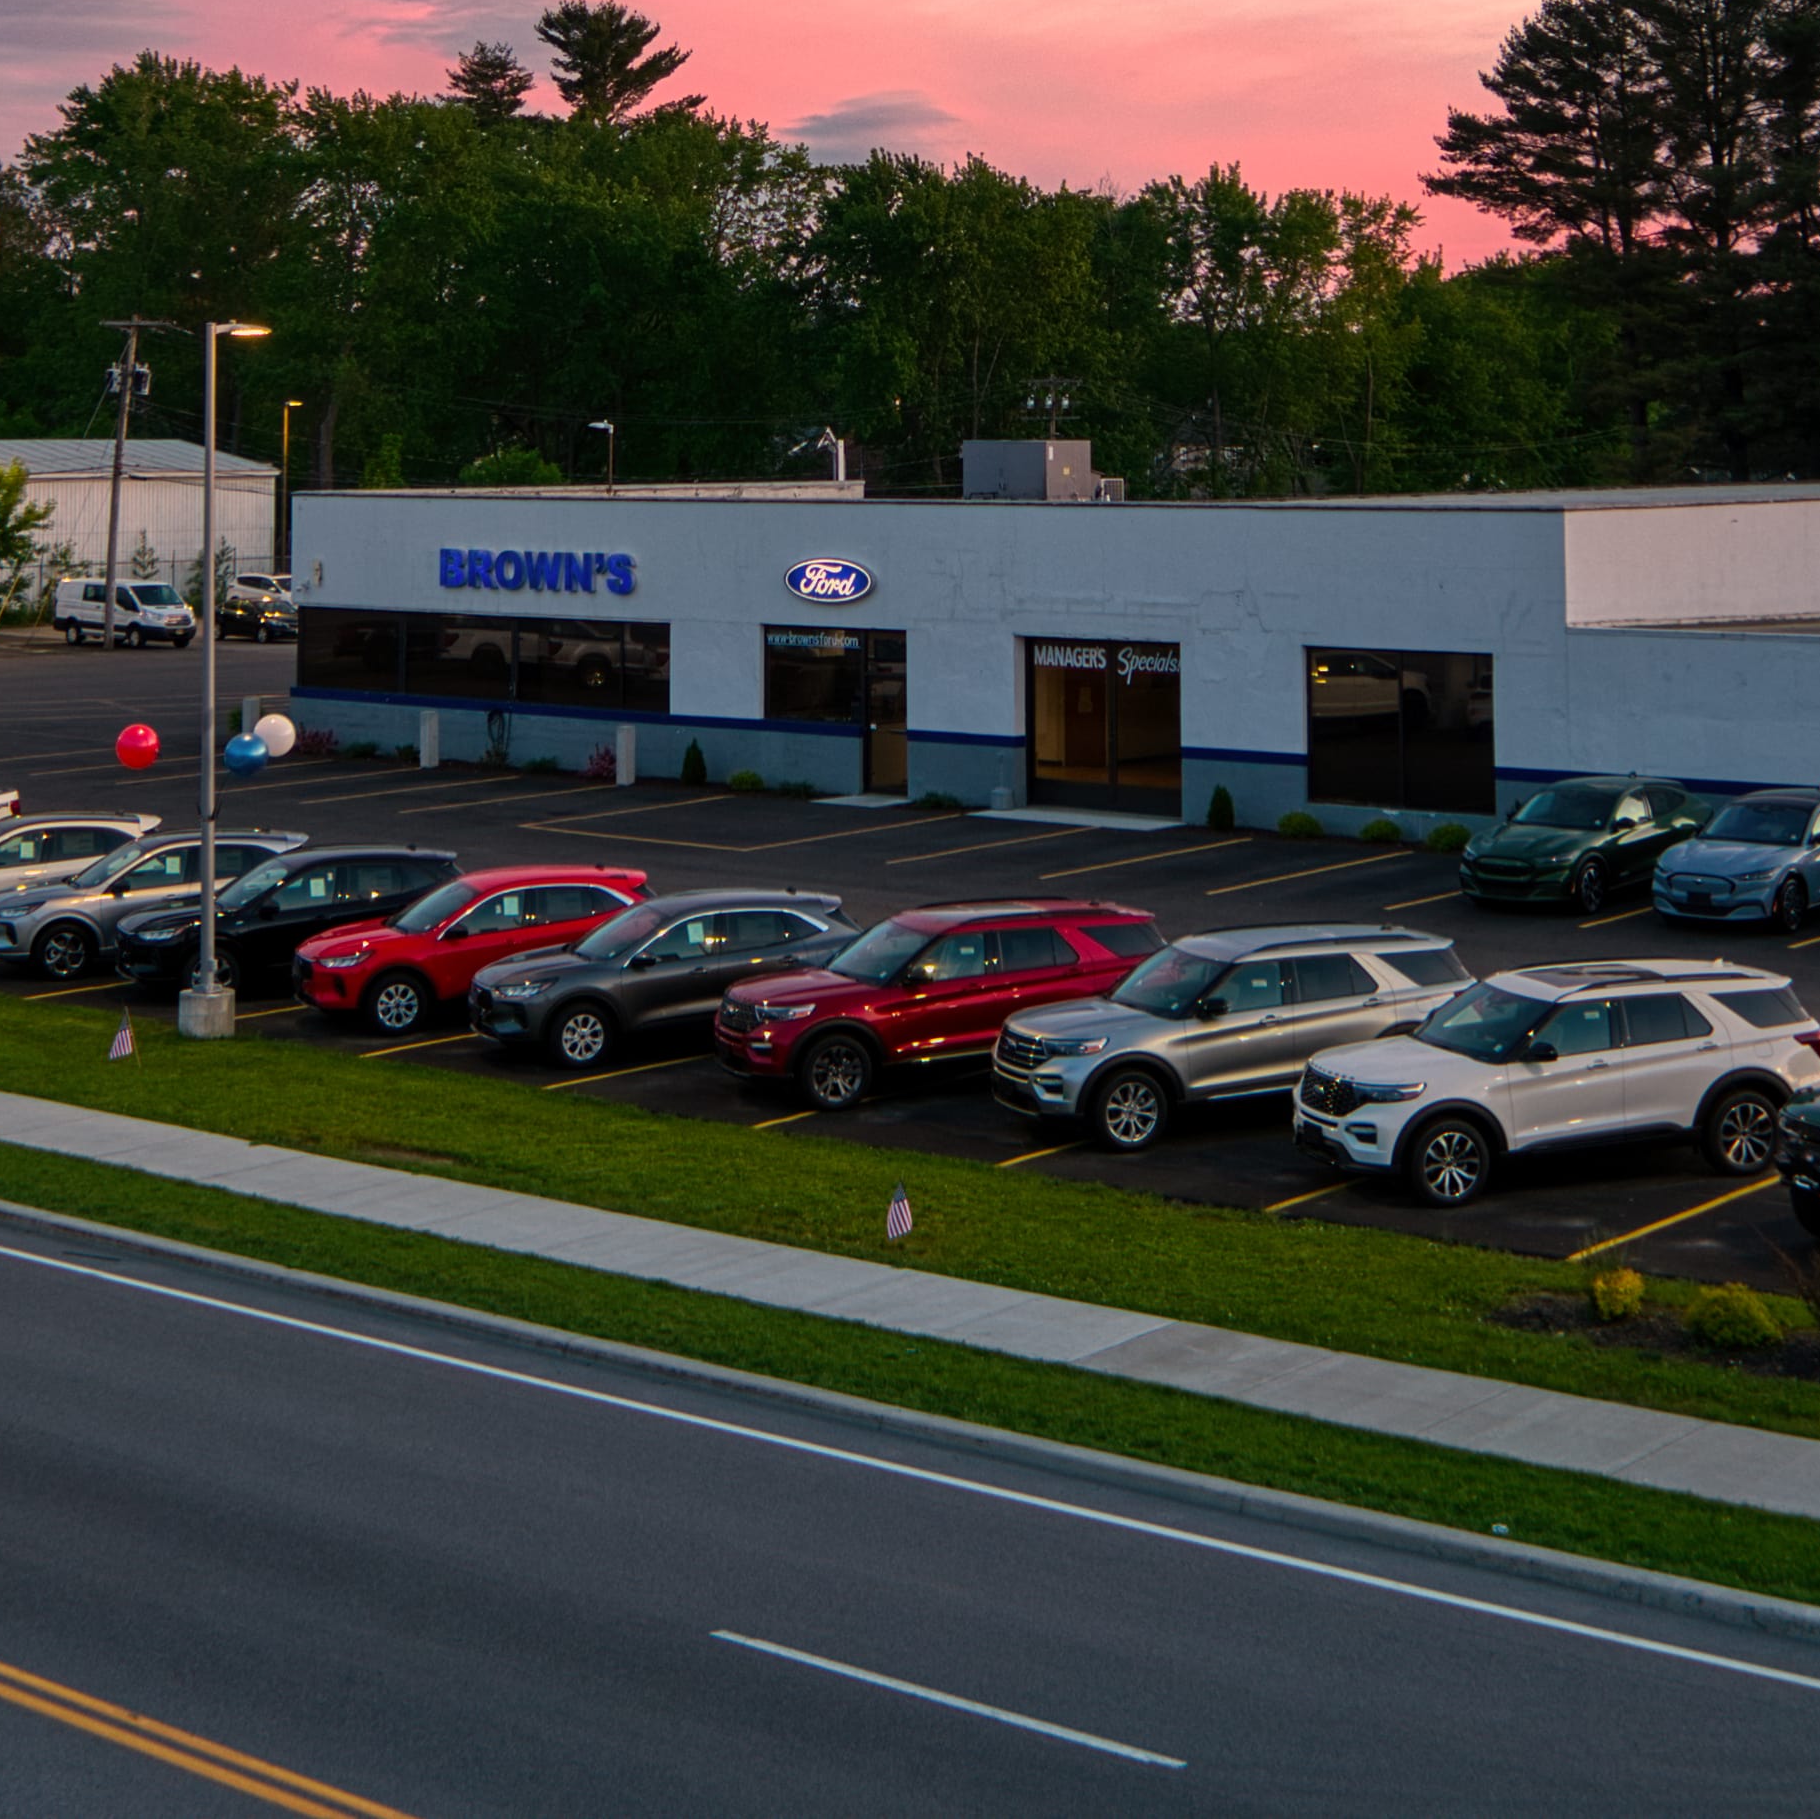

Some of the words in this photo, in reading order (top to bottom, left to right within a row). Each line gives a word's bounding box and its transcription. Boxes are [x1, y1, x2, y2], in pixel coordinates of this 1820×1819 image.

[439, 548, 637, 596] BROWN'S
[799, 563, 857, 596] Ford
[1033, 644, 1107, 669] MANAGER'S
